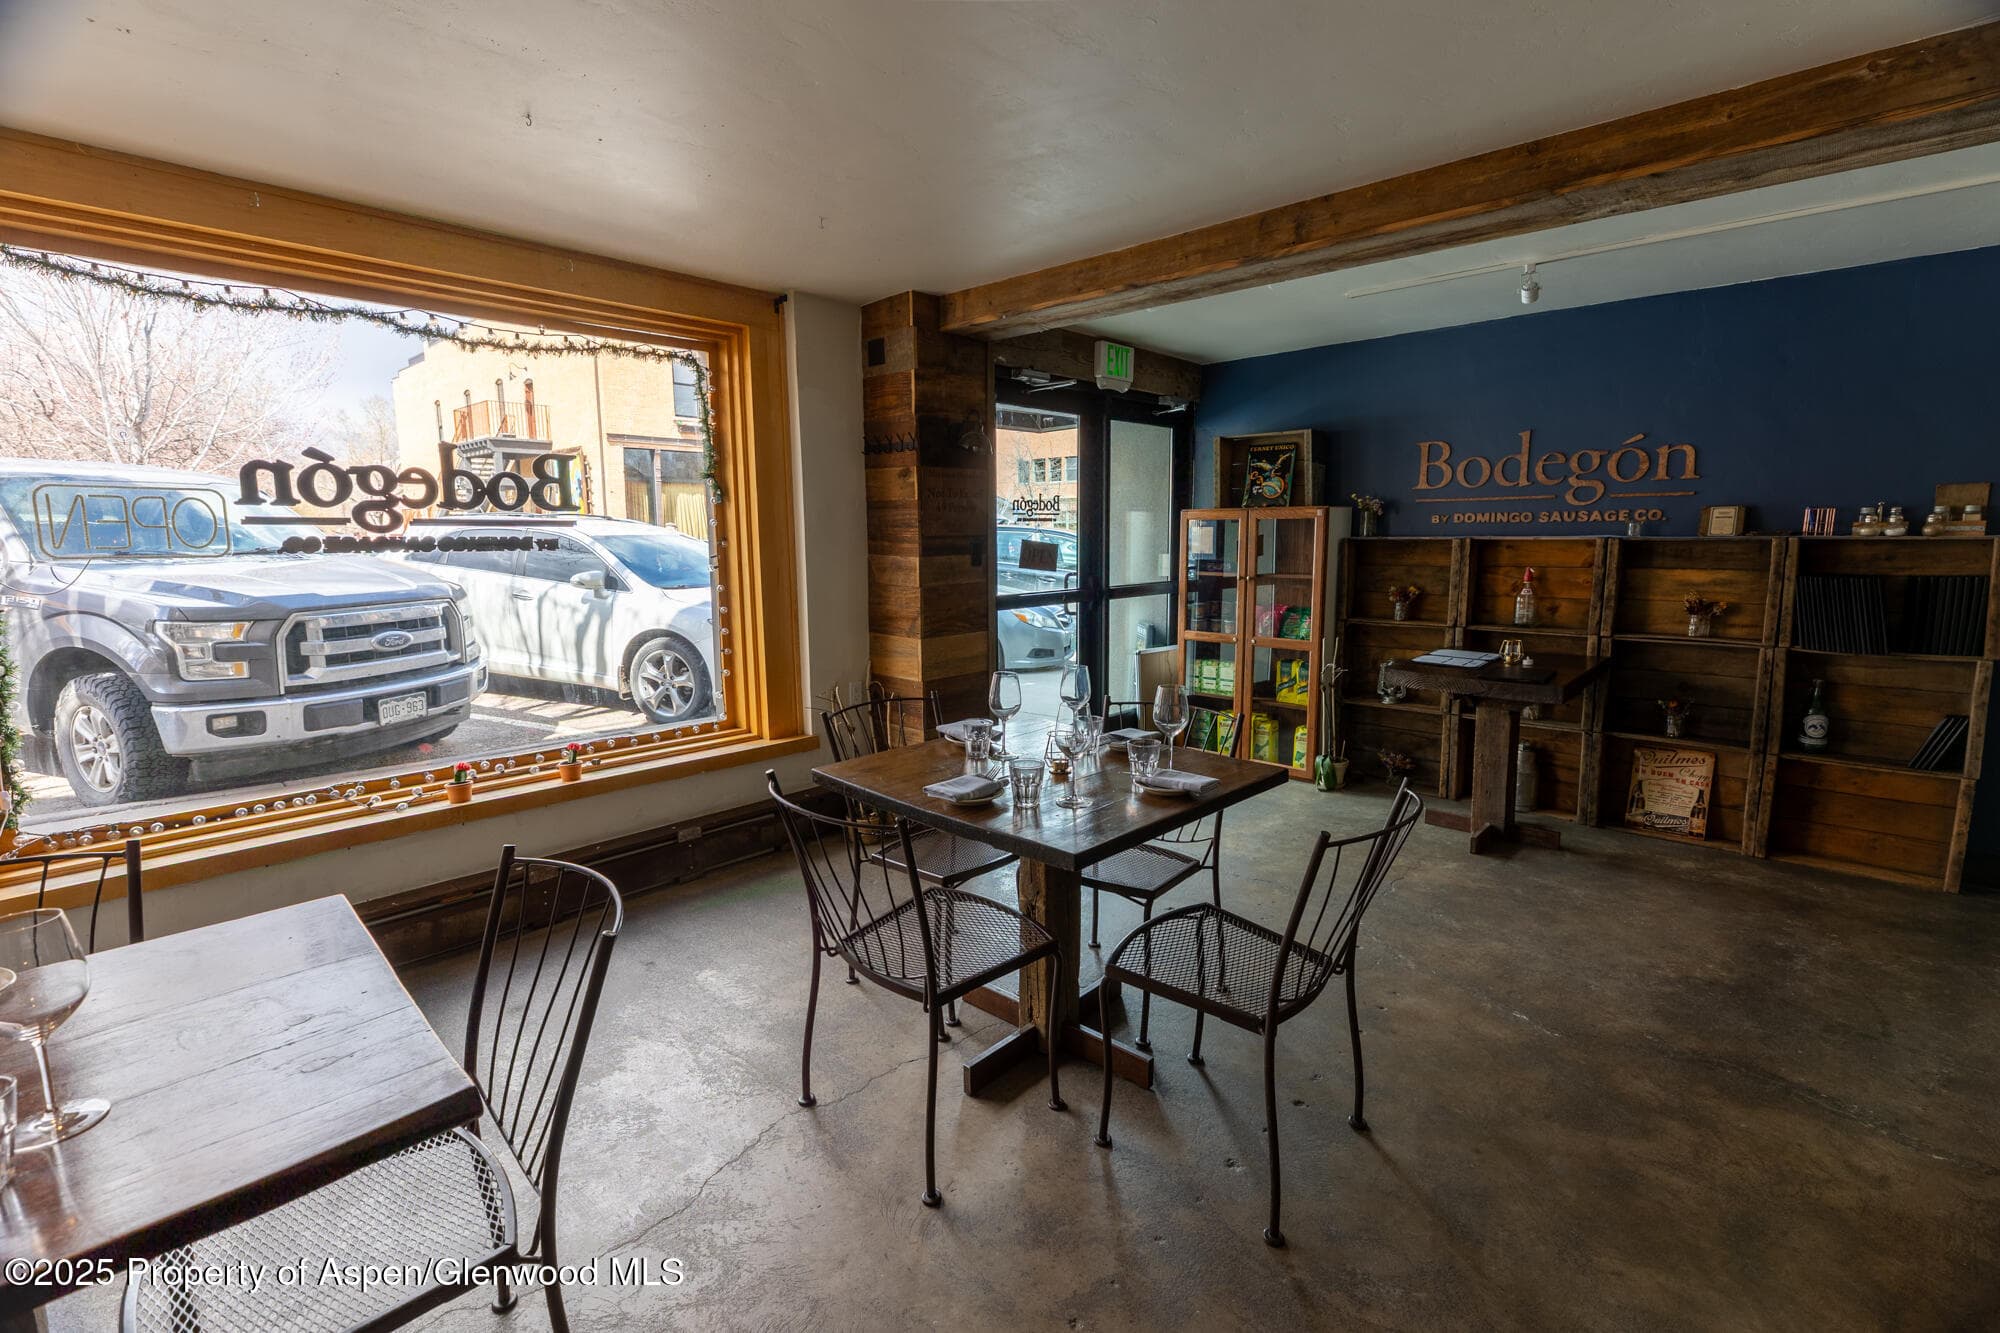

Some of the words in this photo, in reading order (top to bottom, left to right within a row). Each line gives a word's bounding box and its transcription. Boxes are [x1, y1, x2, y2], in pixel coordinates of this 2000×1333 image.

[1107, 343, 1130, 378] EXIT
[1411, 429, 1701, 507] Bodegón
[1432, 513, 1449, 524] BY
[1453, 511, 1533, 524] DOMINGO
[1538, 509, 1630, 523] SAUSAGE
[1634, 508, 1667, 522] CO.
[384, 636, 405, 647] Ford
[1643, 751, 1706, 765] Quilmes
[1642, 814, 1687, 826] Quilmes
